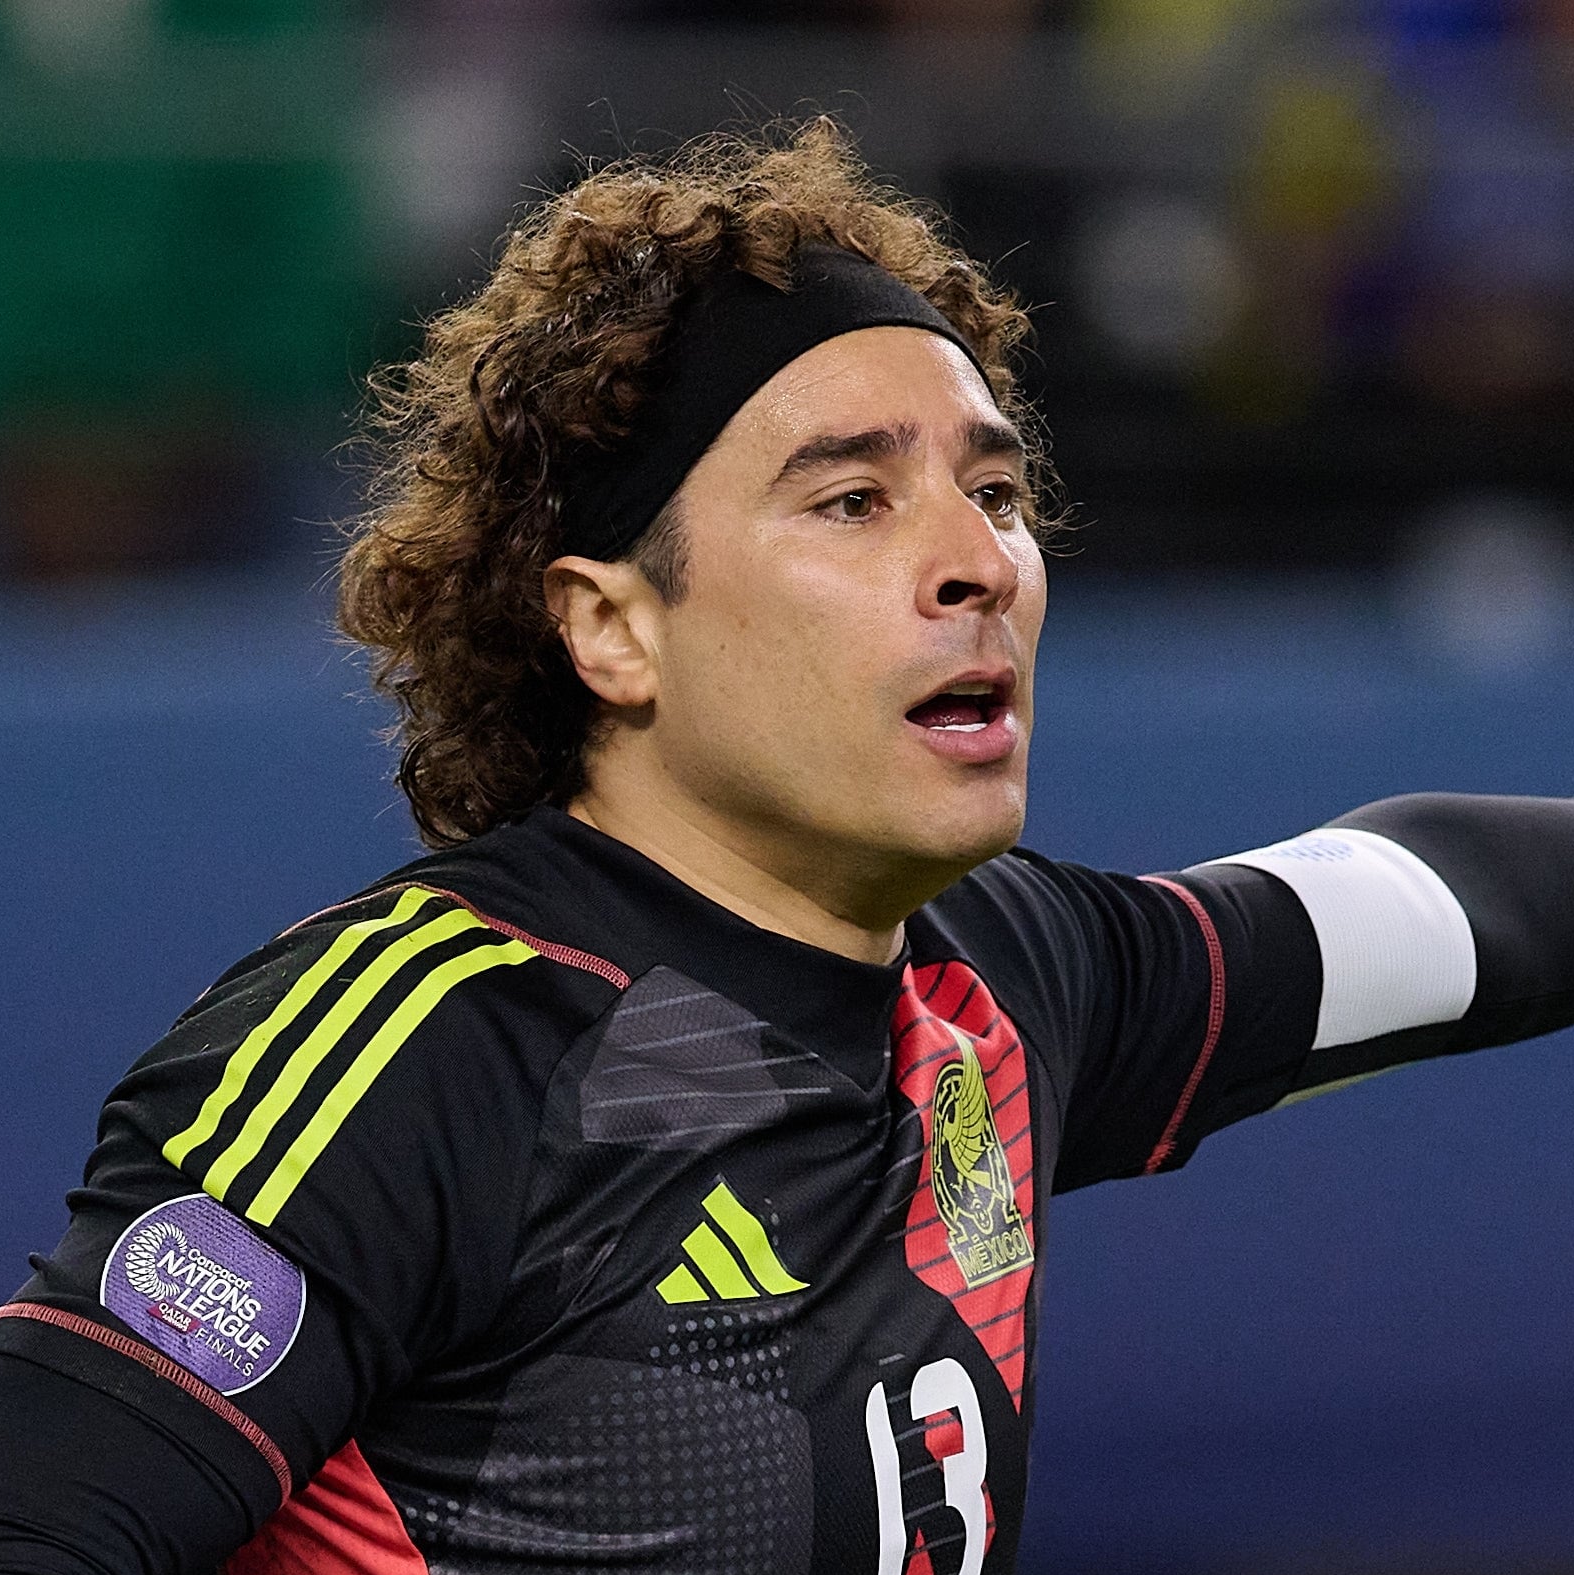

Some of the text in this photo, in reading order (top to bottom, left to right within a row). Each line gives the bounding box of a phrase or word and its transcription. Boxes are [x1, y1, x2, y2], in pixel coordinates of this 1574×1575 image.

[157, 1250, 261, 1321] NATIONS
[188, 1248, 253, 1291] Concacaf
[158, 1302, 192, 1326] QATAR
[174, 1287, 270, 1359] LEAGUE
[195, 1327, 254, 1377] FINALS
